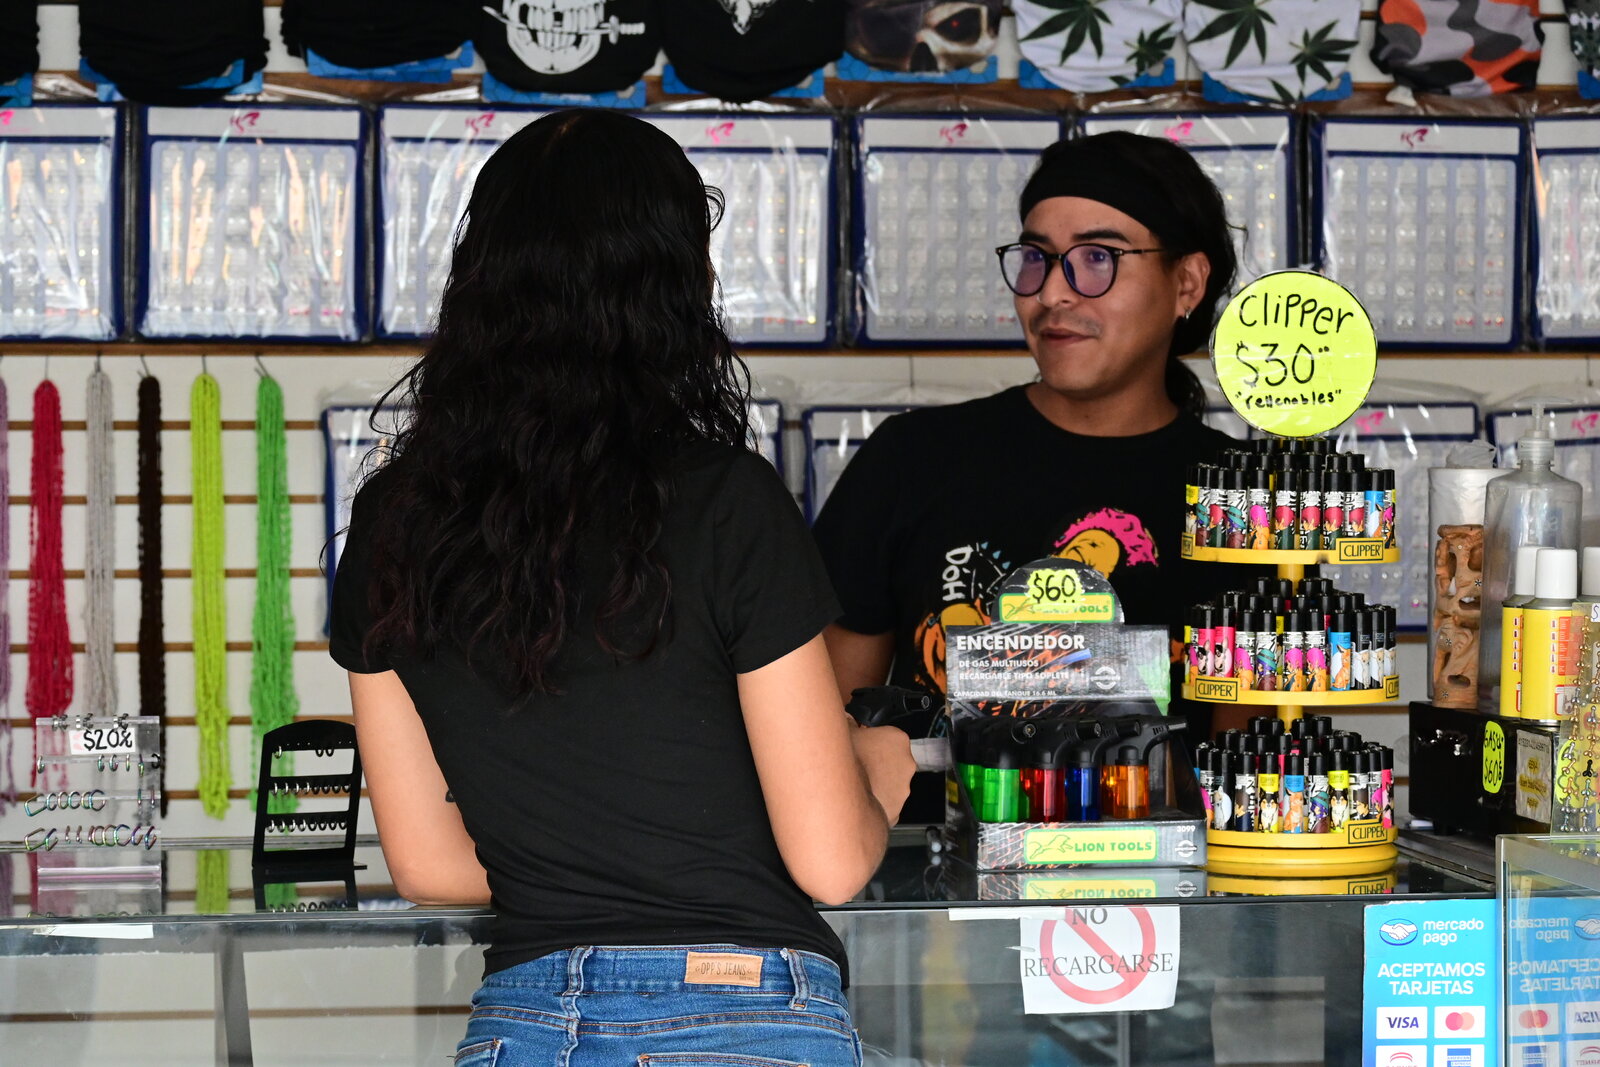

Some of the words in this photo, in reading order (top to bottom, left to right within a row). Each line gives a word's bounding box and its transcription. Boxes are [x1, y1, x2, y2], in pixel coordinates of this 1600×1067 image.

[1343, 544, 1381, 557] CLIPPER
[957, 635, 1085, 650] ENCENDEDOR
[1197, 683, 1233, 697] CLIPPER
[1352, 826, 1385, 840] CLIPPER
[1074, 842, 1105, 852] LION
[1110, 841, 1152, 852] TOOLS
[1072, 908, 1108, 926] NO
[1422, 918, 1485, 931] mercado
[1423, 933, 1458, 946] pago
[723, 962, 747, 976] JEANS
[1024, 953, 1174, 977] RECARGARSE
[1377, 962, 1486, 978] ACEPTAMOS
[1389, 980, 1474, 995] TARJETAS
[1386, 1017, 1419, 1029] VISA
